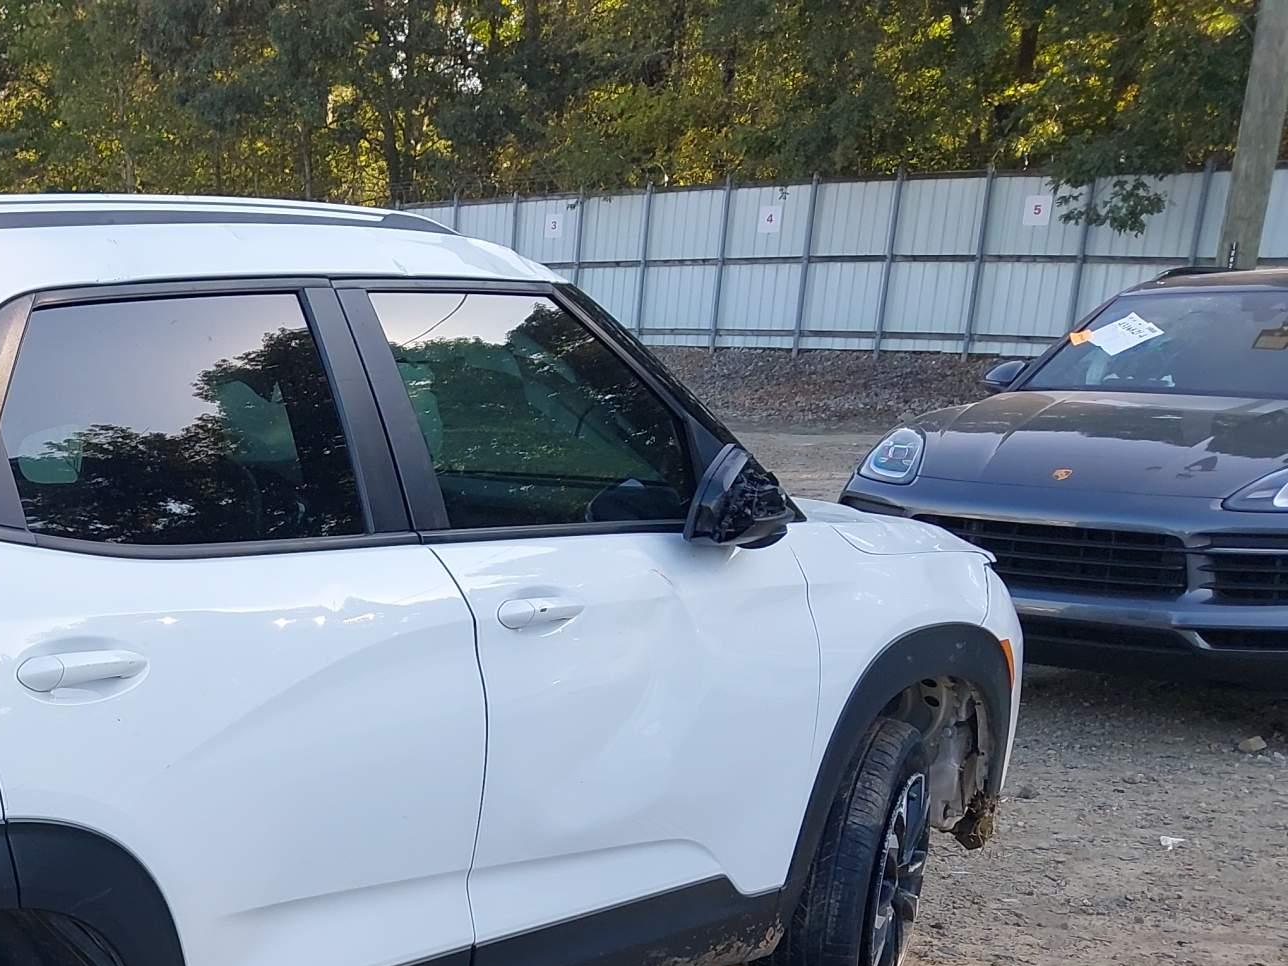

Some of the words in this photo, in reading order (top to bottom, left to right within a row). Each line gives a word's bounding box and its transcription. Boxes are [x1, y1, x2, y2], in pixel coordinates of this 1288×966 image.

[1033, 204, 1042, 216] 5
[766, 213, 774, 224] 4
[551, 220, 558, 231] 3
